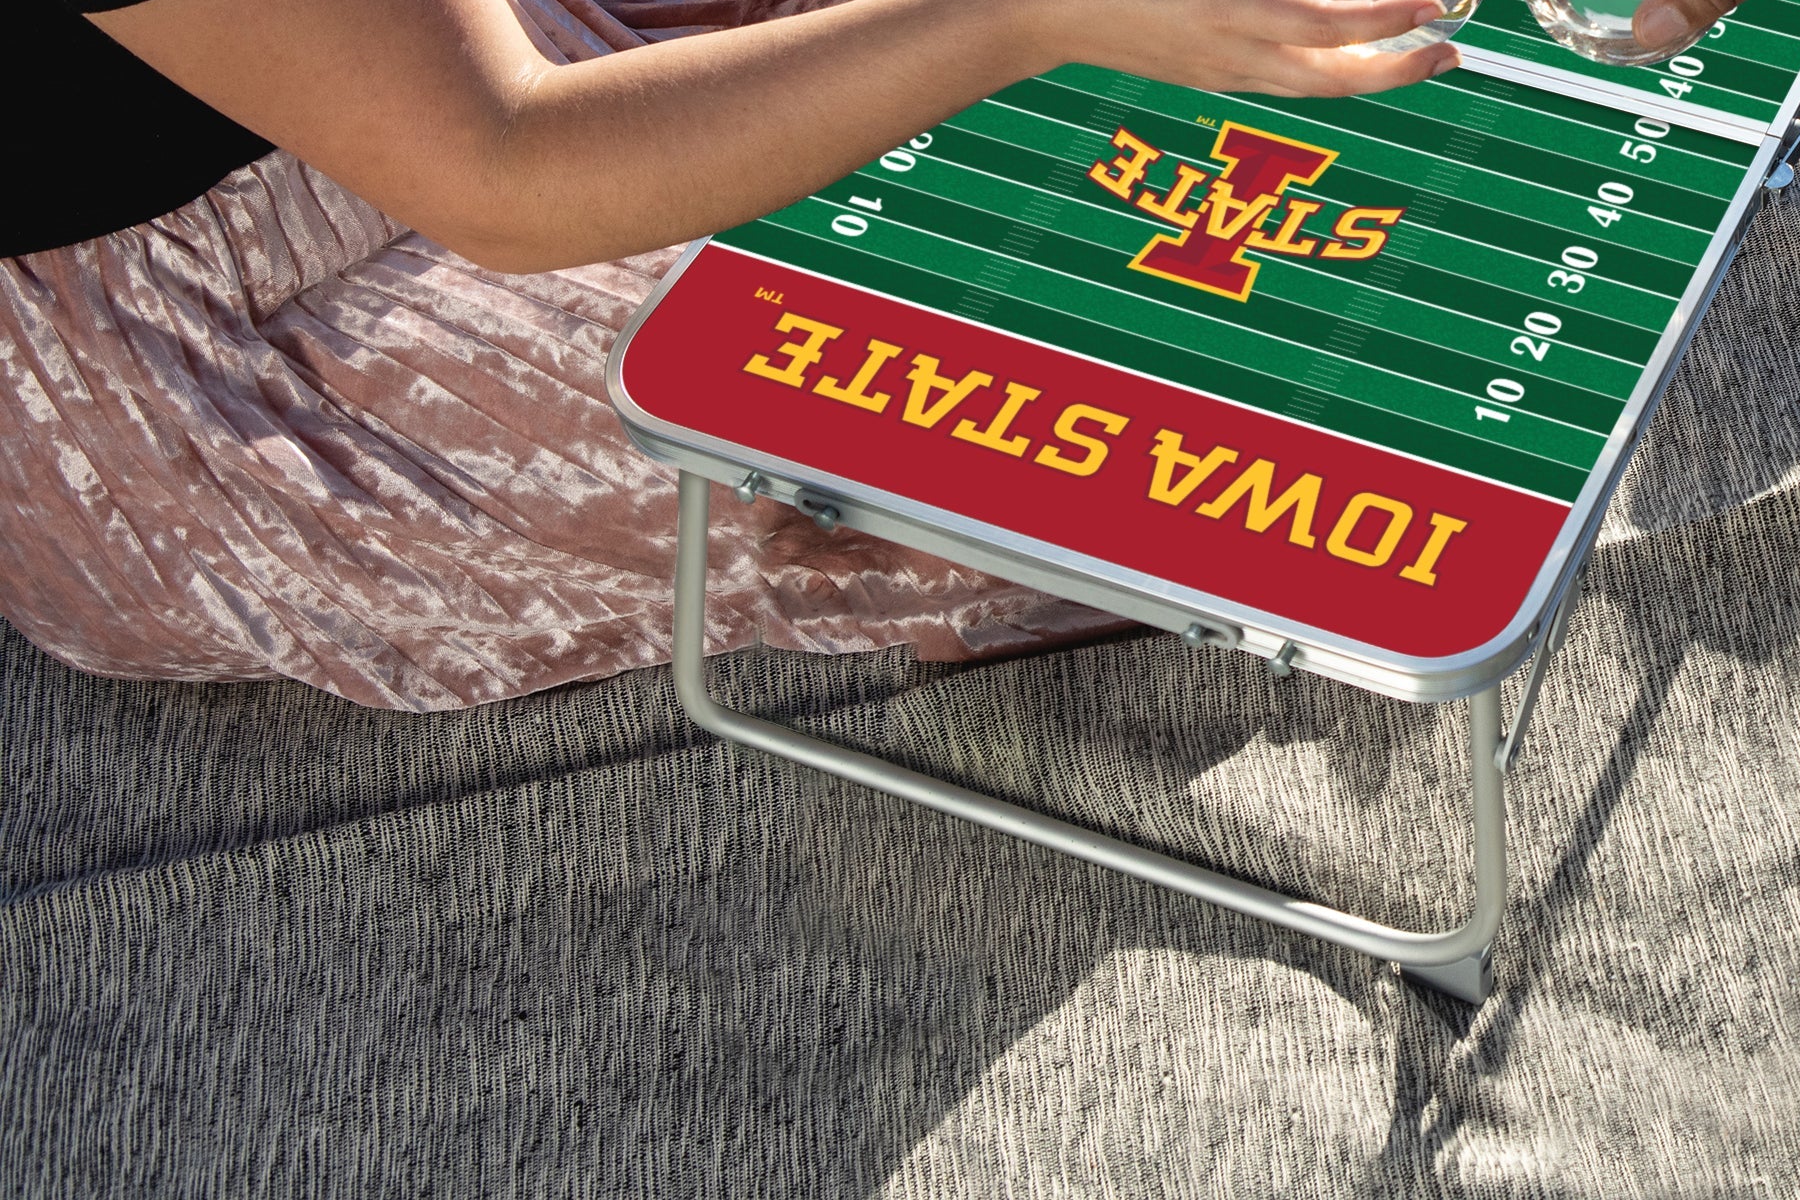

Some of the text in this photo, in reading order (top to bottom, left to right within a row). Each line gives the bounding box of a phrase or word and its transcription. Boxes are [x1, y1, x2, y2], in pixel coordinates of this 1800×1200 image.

[1659, 55, 1704, 99] 40
[1619, 117, 1671, 164] 50
[831, 195, 883, 237] 10
[1087, 127, 1405, 260] STATE
[1587, 181, 1634, 228] 40
[1547, 246, 1599, 294] 30
[1510, 311, 1562, 362] 20
[743, 312, 1130, 477] STATE
[1474, 378, 1525, 423] 10
[1148, 428, 1468, 587] IOWA
